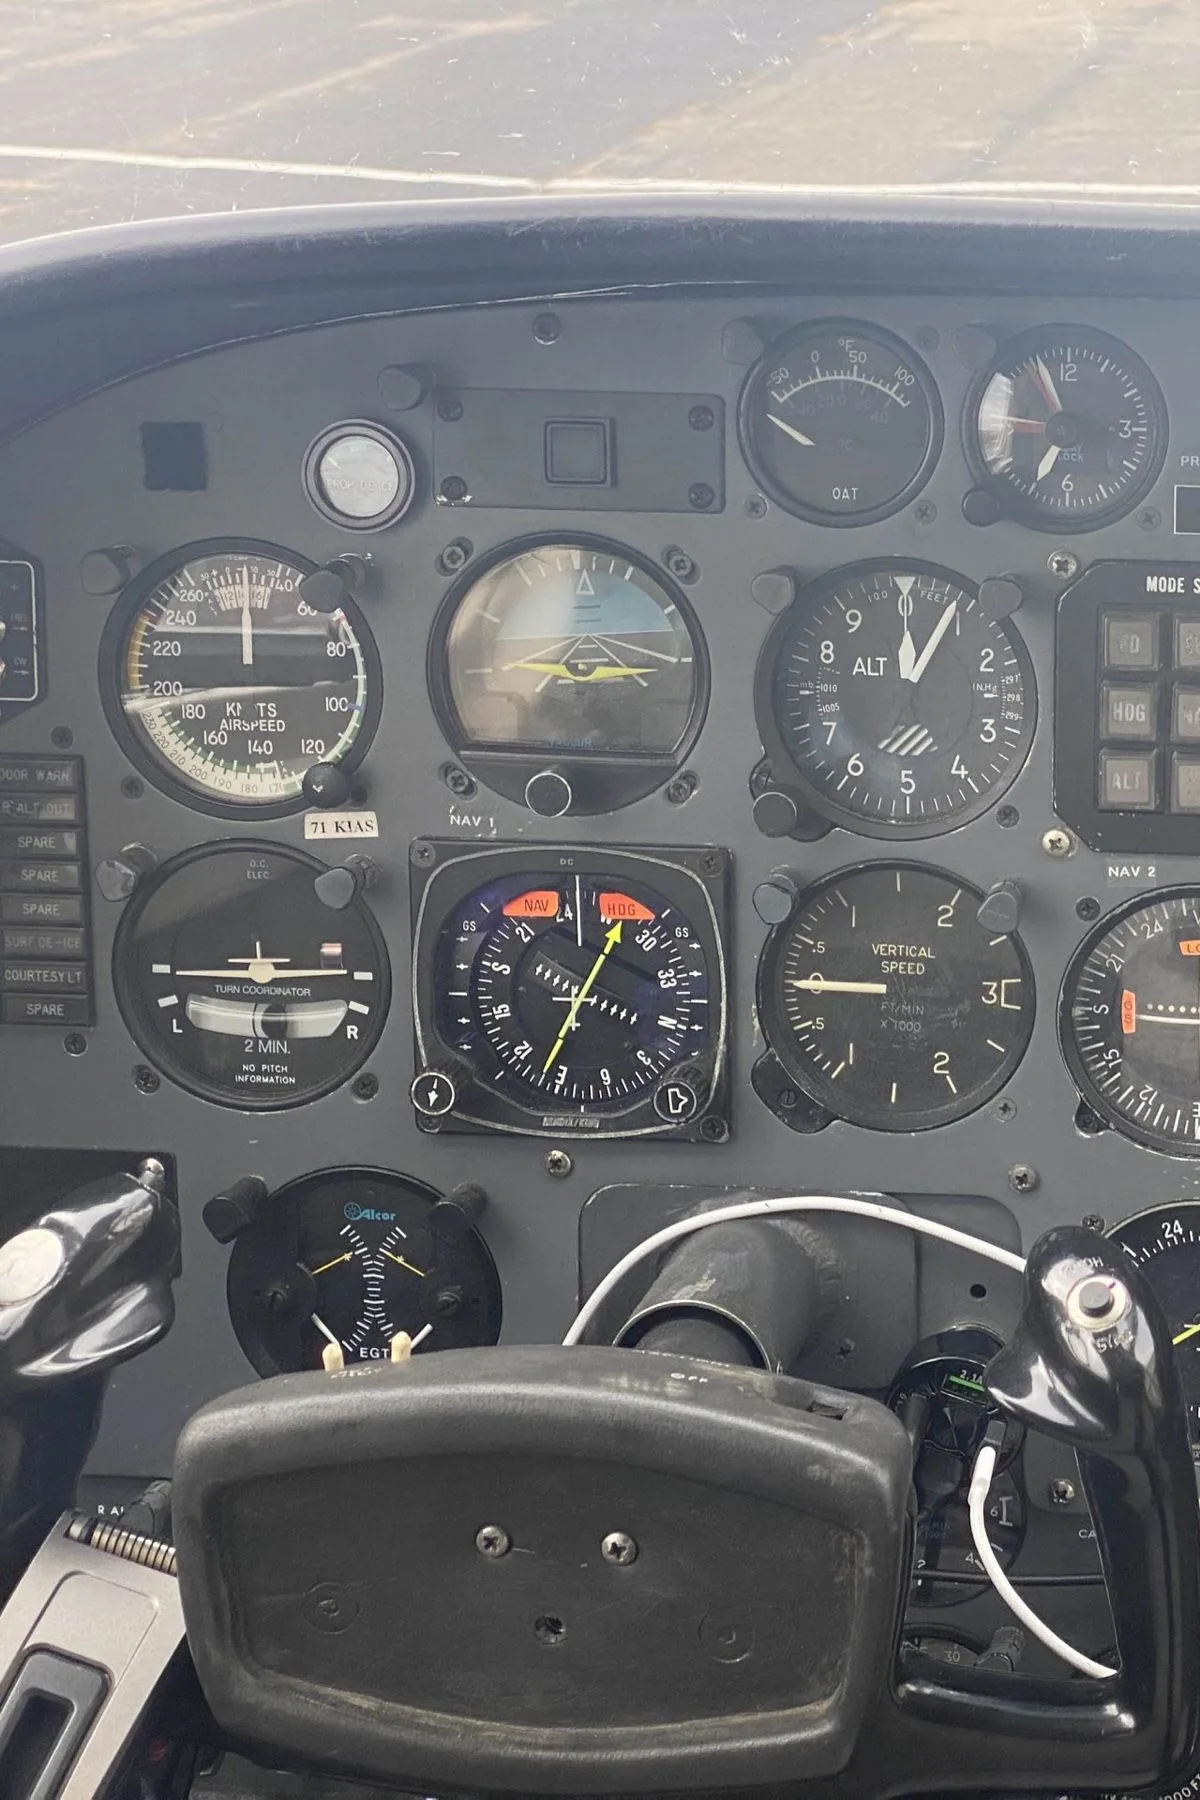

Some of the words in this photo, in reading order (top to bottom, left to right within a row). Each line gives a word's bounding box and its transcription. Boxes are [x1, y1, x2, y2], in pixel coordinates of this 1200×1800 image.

[1060, 364, 1076, 381] 12
[832, 487, 858, 500] OAT
[1147, 576, 1185, 593] MODE
[180, 589, 203, 602] 260
[920, 591, 948, 604] FEET
[166, 611, 196, 626] 240
[153, 642, 181, 656] 220
[327, 642, 346, 657] 80
[852, 658, 887, 676] ALT
[153, 681, 182, 696] 200
[325, 697, 347, 711] 100
[181, 704, 205, 719] 180
[1112, 704, 1145, 722] HDG
[220, 720, 285, 732] AIRSPEED
[203, 731, 227, 745] 160
[248, 740, 273, 755] 140
[301, 740, 324, 753] 120
[311, 822, 326, 833] 71
[335, 820, 374, 832] KIAS
[18, 837, 56, 848] SPARE
[22, 870, 59, 881] SPARE
[1109, 866, 1140, 877] NAV
[1148, 867, 1155, 877] 2
[23, 904, 60, 915] SPARE
[524, 900, 548, 912] NAV
[463, 921, 476, 931] GS
[675, 927, 688, 938] GS
[872, 944, 936, 958] VERTICAL
[882, 962, 925, 974] SPEED
[4, 970, 64, 982] COURTESY
[68, 972, 82, 982] LT
[215, 985, 239, 993] TURN
[242, 986, 310, 996] COORDINATOR
[27, 1004, 64, 1015] SPARE
[881, 1003, 924, 1014] FT/MIN
[172, 1019, 182, 1033] L
[347, 1026, 358, 1039] R
[262, 1065, 288, 1073] PITCH
[235, 1075, 295, 1083] INFORMATION
[360, 1348, 390, 1358] EGT
